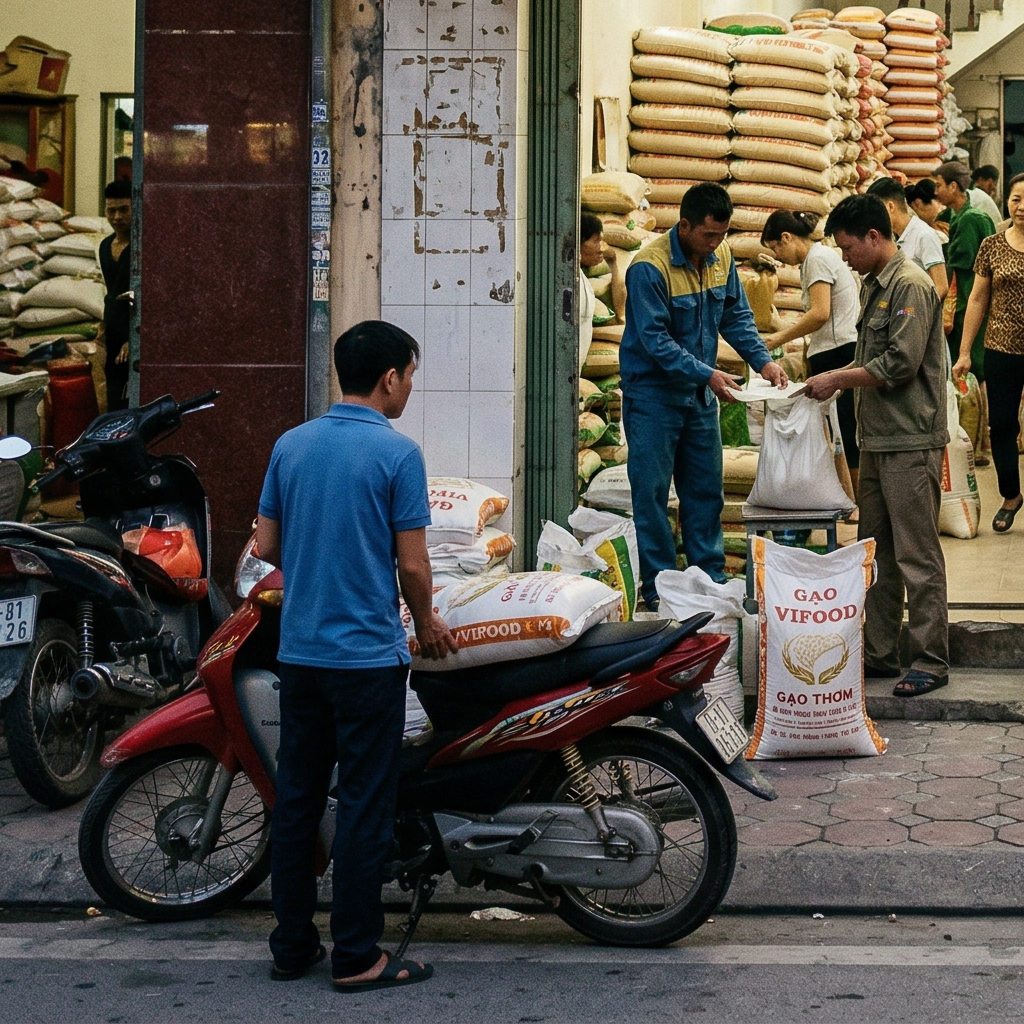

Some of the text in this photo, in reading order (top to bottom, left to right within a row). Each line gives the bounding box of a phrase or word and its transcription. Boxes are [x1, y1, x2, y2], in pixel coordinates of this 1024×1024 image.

[794, 588, 837, 605] GẠO
[775, 604, 857, 624] VIFOOD
[776, 688, 853, 707] GẠO THƠM
